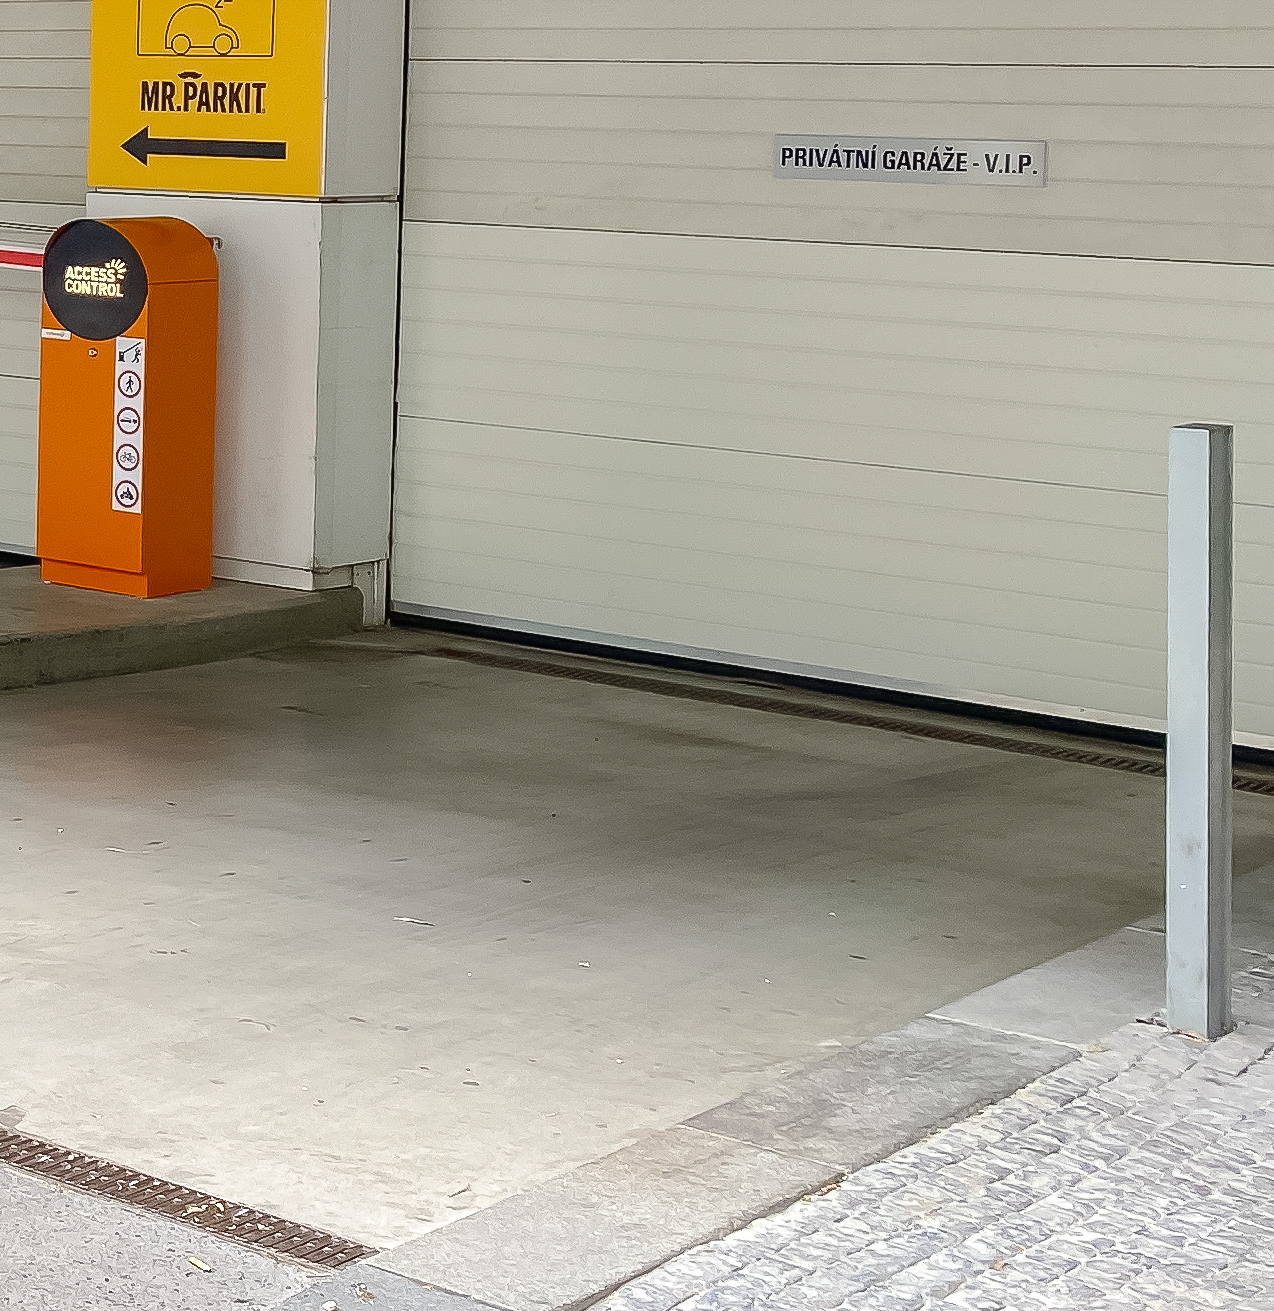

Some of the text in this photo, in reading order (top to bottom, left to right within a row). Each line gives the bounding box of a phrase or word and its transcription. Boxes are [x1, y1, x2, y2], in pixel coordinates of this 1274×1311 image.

[140, 80, 267, 114] MR.PARKIT
[780, 143, 877, 170] PRIVÁTNÍ
[882, 146, 968, 172] GARÁŽE
[984, 153, 1038, 175] V.I.P.
[64, 265, 117, 283] ACCESS
[64, 278, 125, 298] CONTROL
